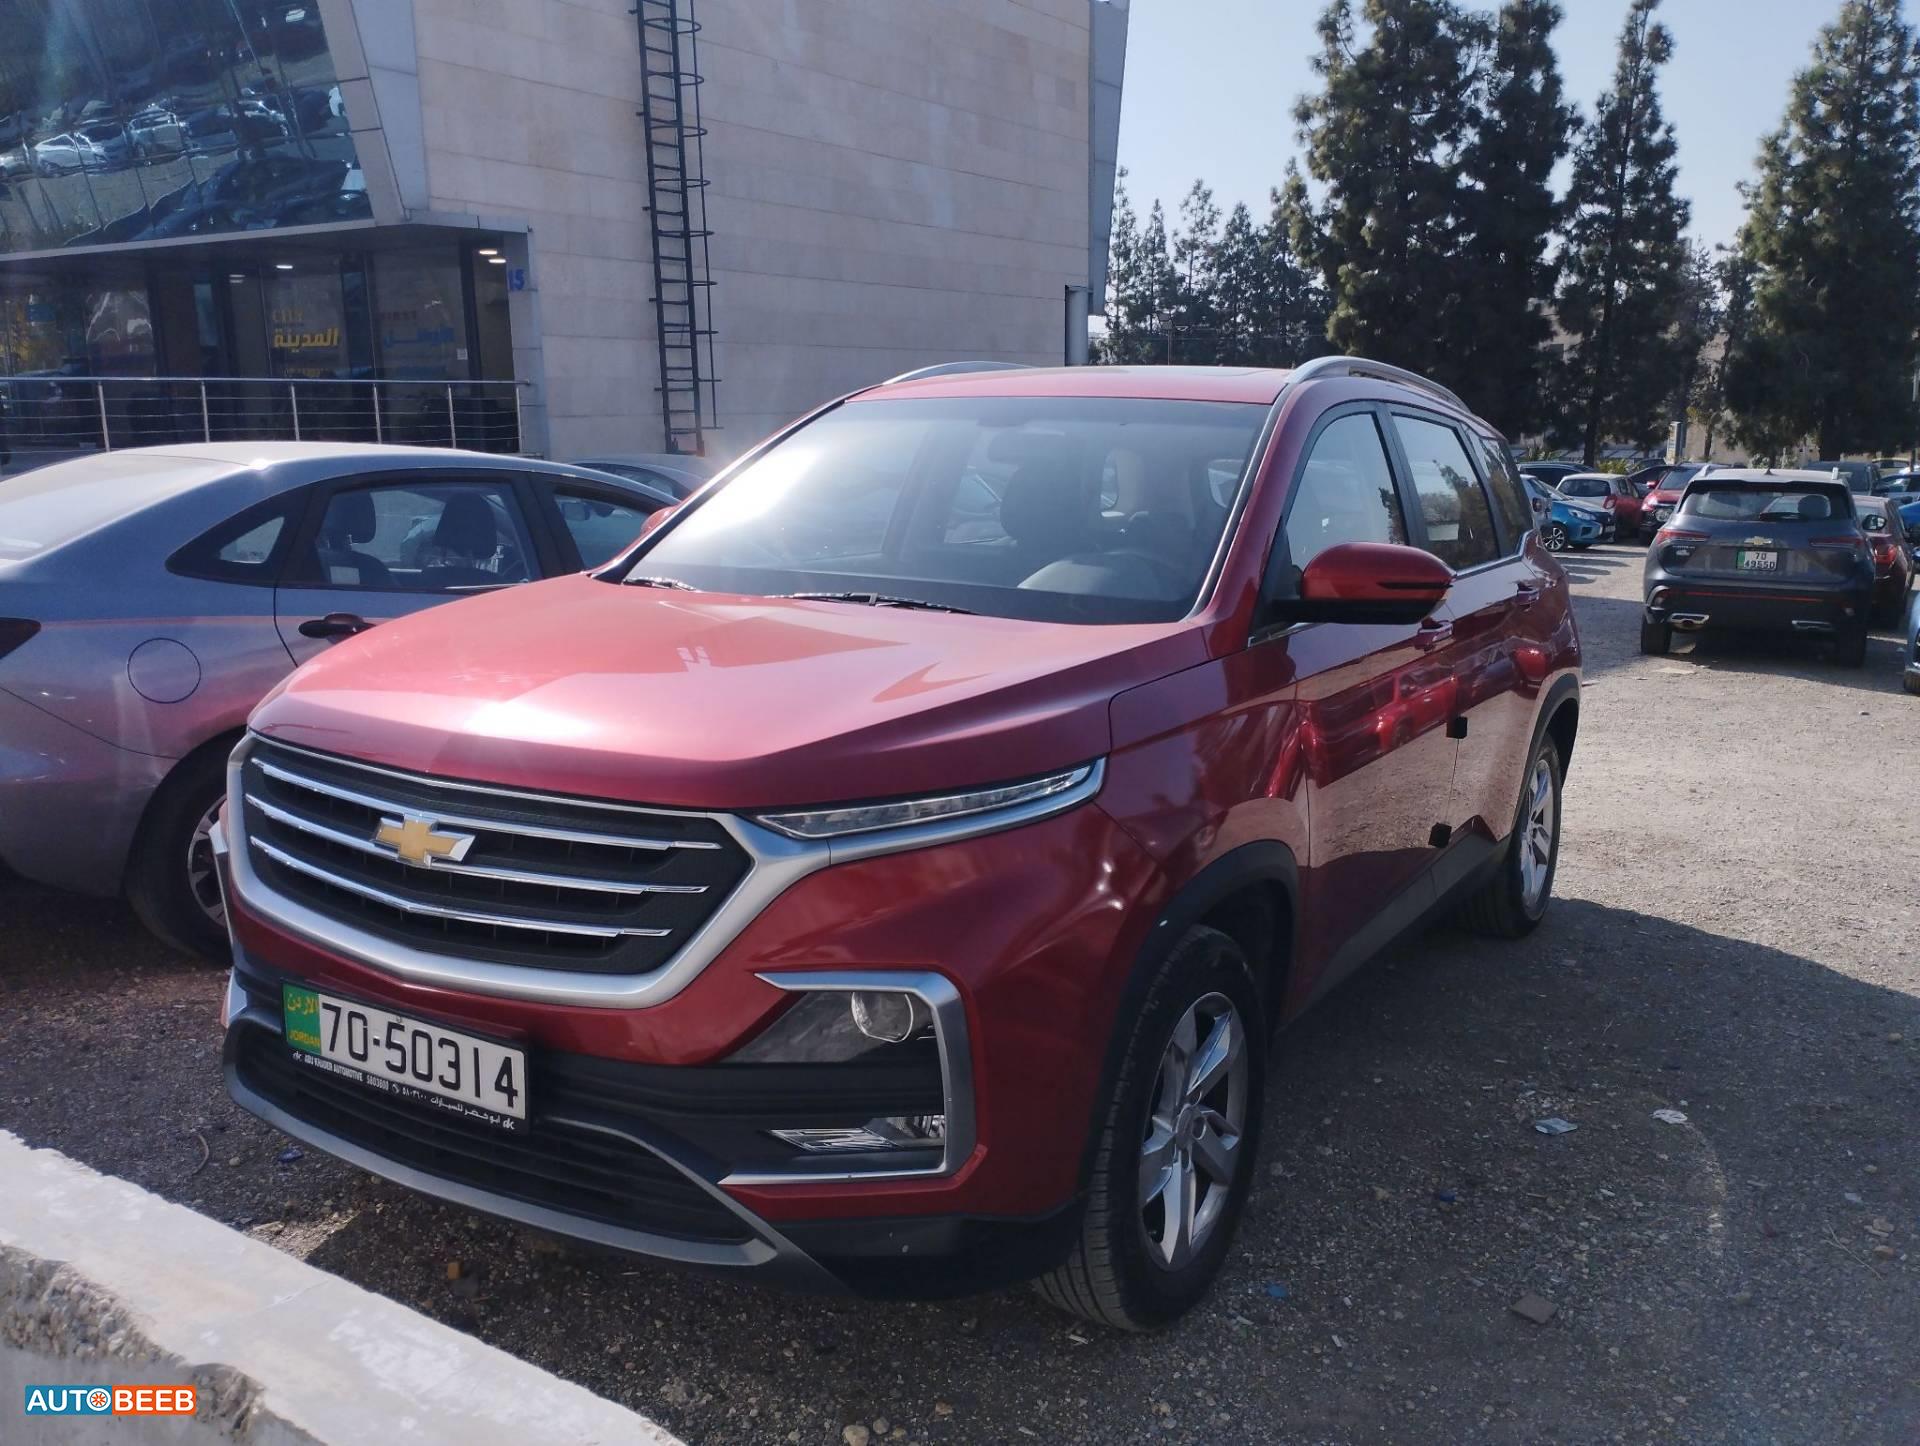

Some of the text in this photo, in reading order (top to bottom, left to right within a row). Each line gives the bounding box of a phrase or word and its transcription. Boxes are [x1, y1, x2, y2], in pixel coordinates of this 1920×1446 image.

[273, 327, 339, 353] المدينة
[1755, 552, 1767, 561] 70
[322, 1003, 518, 1108] 70-50314
[333, 1063, 363, 1082] AUTOMOTIVE
